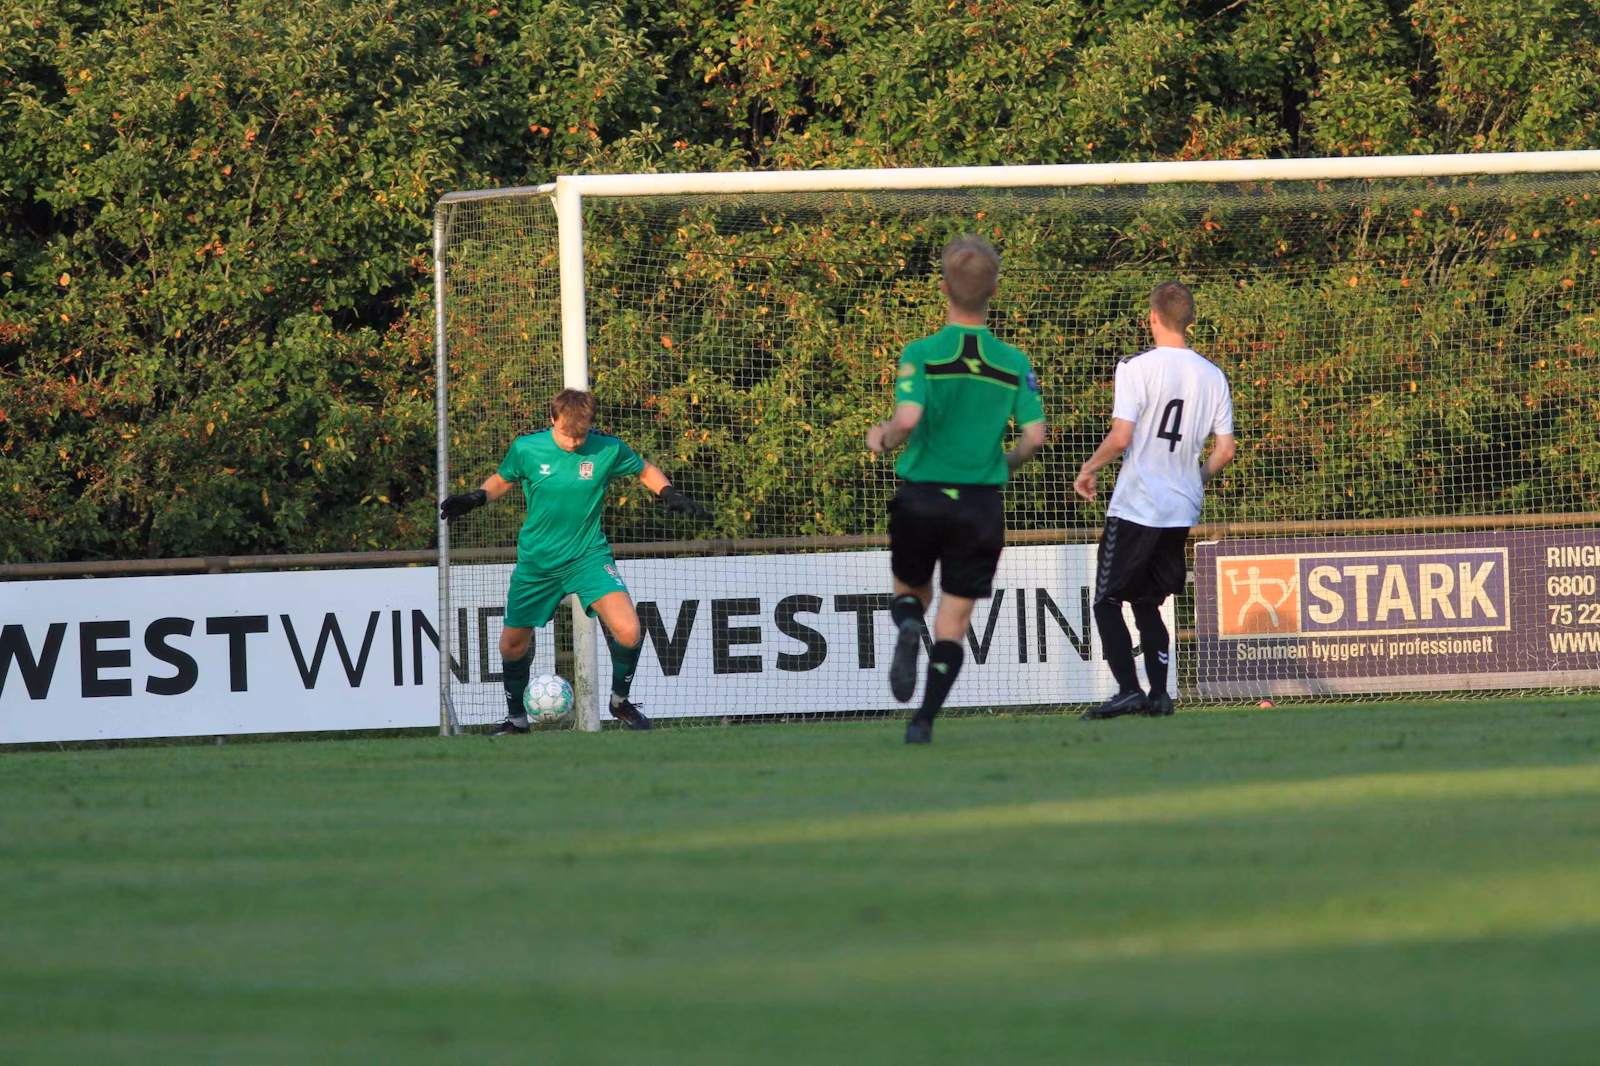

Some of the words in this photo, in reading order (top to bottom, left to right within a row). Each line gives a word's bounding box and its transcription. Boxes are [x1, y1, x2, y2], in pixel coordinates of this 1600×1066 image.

[1157, 398, 1184, 452] 4
[1308, 561, 1498, 624] STARK
[1547, 575, 1596, 597] 6800
[597, 586, 1146, 676] WESTWIN
[1548, 604, 1573, 625] 75
[1578, 603, 1600, 624] 22
[1237, 643, 1307, 661] Sammen
[1312, 641, 1365, 662] bygger
[1370, 639, 1384, 656] vi
[1389, 636, 1493, 659] professionelt
